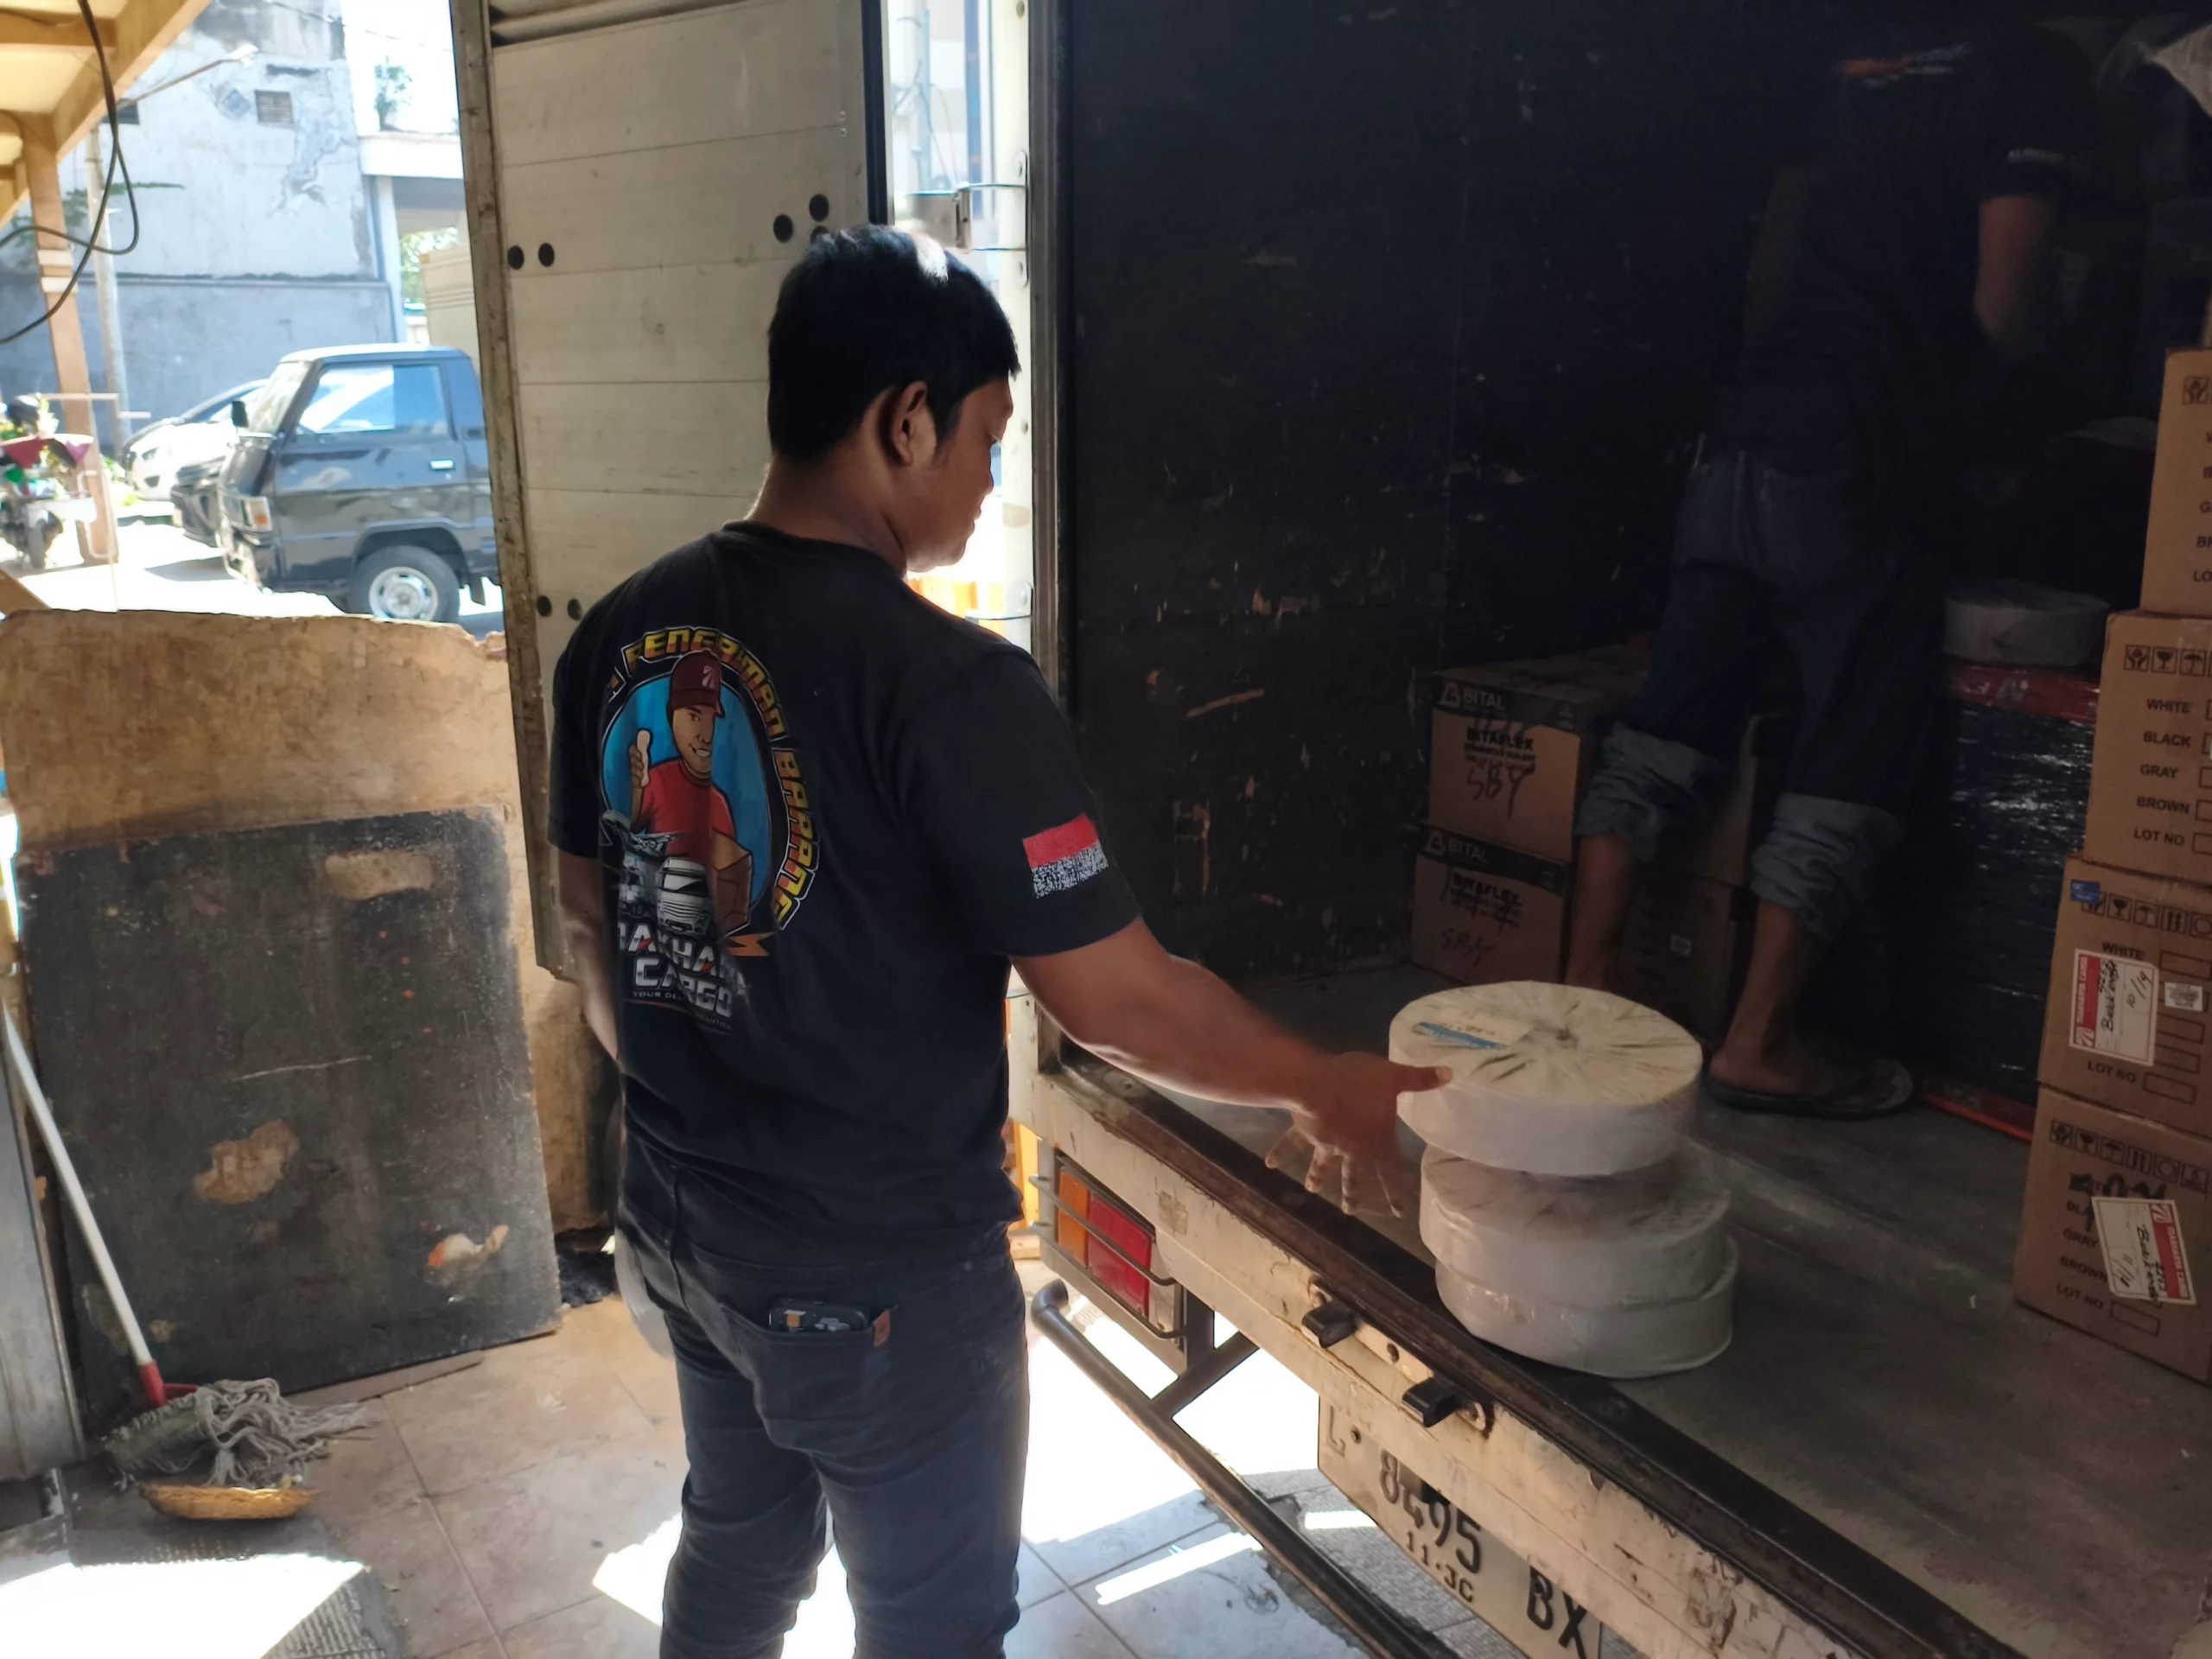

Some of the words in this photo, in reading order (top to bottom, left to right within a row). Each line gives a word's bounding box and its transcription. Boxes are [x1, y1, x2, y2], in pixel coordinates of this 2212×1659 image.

[1464, 689, 1505, 711] BITAL
[2147, 698, 2191, 714] WHITE
[2144, 731, 2191, 748] BLACK
[2140, 764, 2179, 779] GRAY
[2137, 796, 2190, 814] BROWN
[2134, 828, 2160, 842] LOT
[2164, 833, 2185, 847] NO
[1449, 838, 1490, 864] BITAL
[2102, 942, 2144, 960] WHITE
[2088, 1059, 2113, 1077] LOT
[2116, 1069, 2137, 1084] NO
[2063, 1227, 2098, 1249] GRAY
[2060, 1255, 2107, 1284] BROWN
[2056, 1282, 2081, 1300] LOT
[2083, 1294, 2104, 1310] NO
[1526, 1564, 1587, 1659] BX
